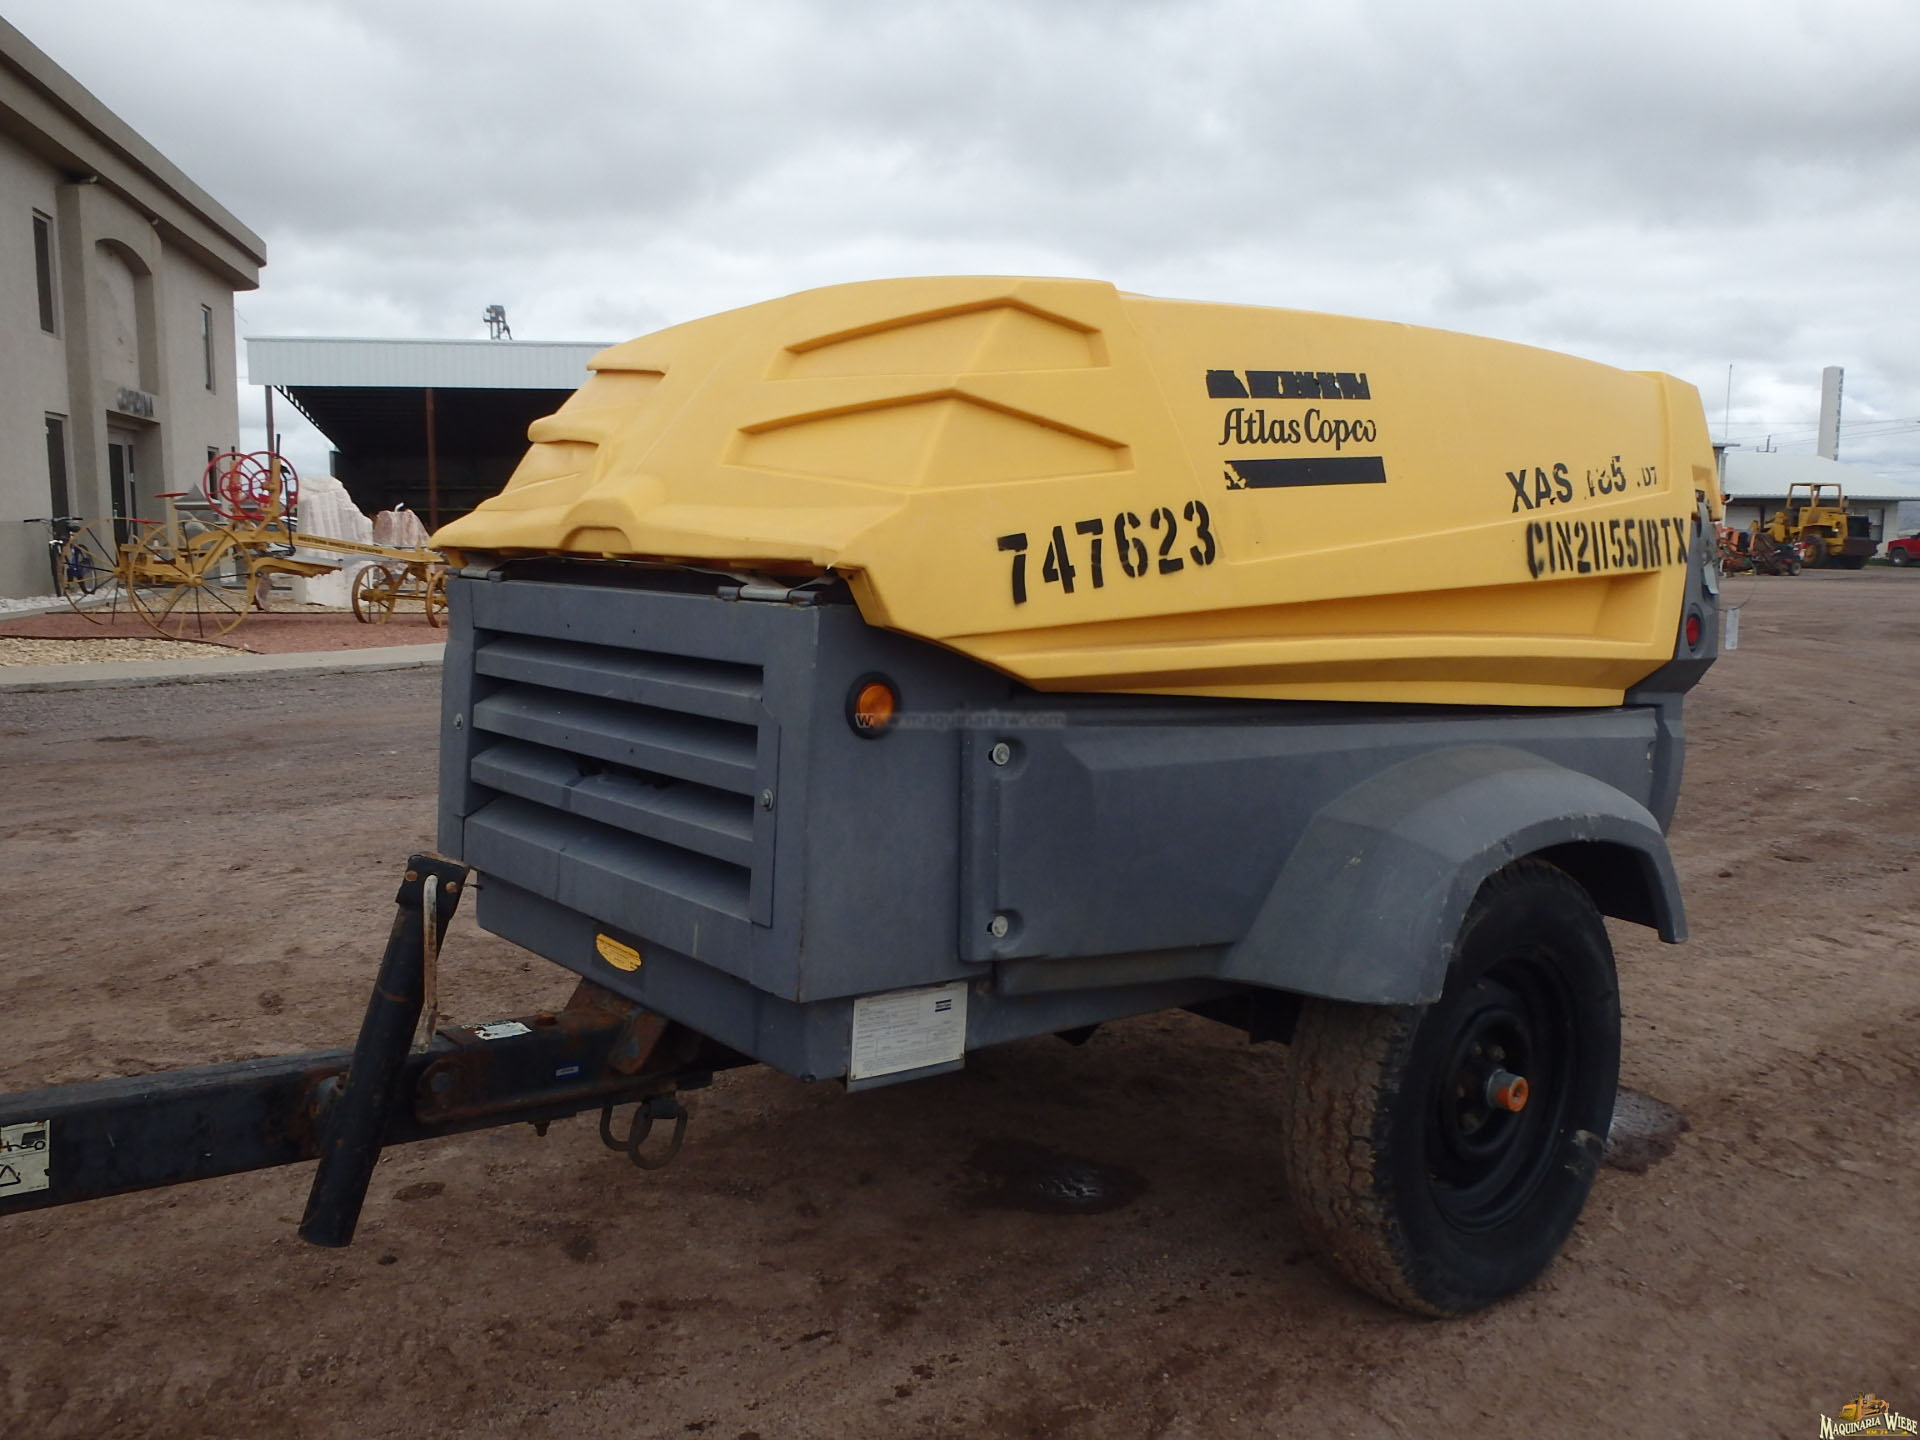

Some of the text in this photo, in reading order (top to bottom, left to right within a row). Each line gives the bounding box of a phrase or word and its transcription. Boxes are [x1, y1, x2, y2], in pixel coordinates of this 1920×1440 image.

[1218, 408, 1377, 451] Atlas Copco
[1505, 462, 1573, 514] XAS
[997, 499, 1216, 606] 747623
